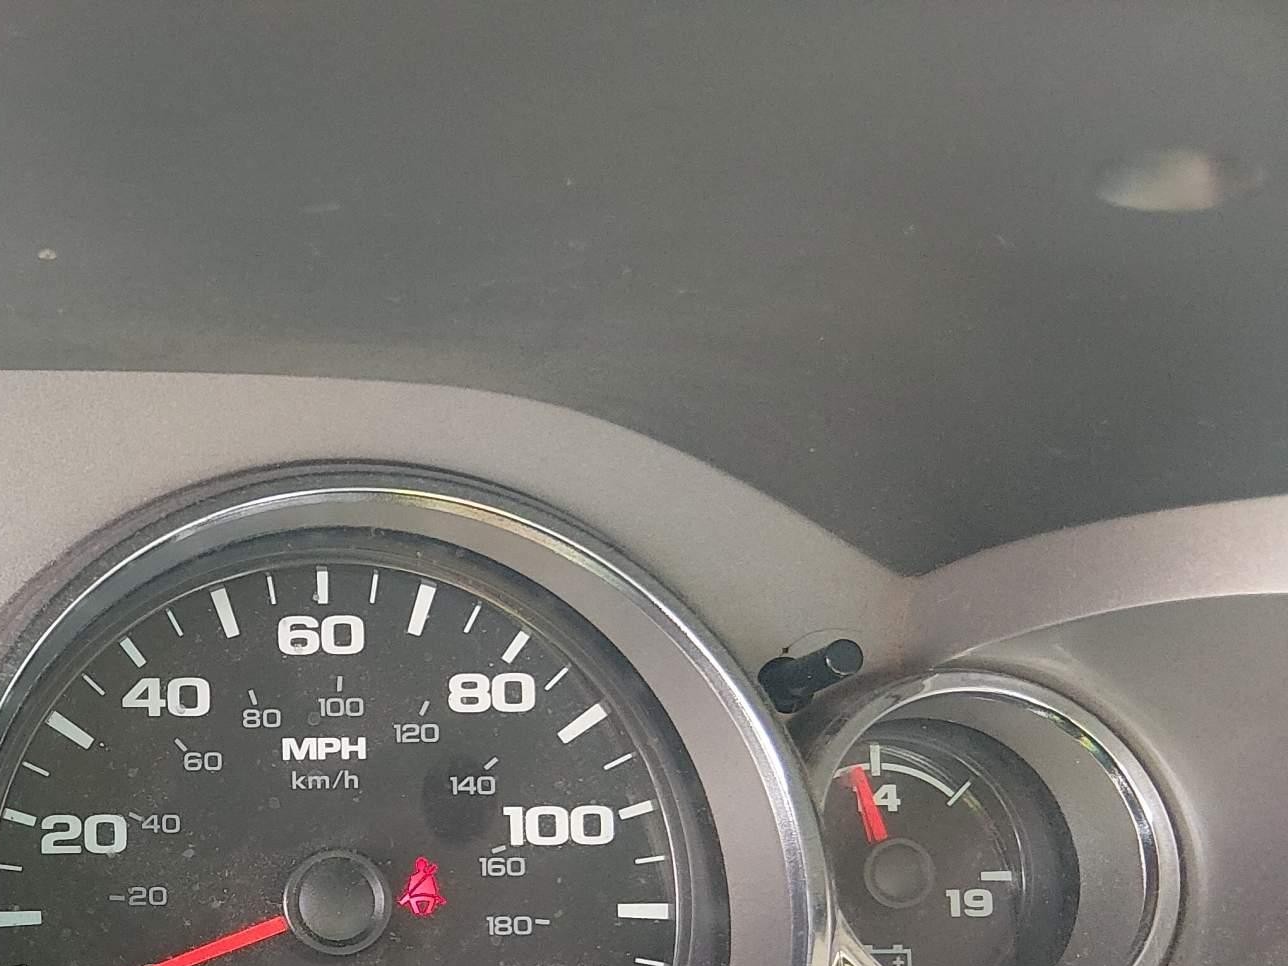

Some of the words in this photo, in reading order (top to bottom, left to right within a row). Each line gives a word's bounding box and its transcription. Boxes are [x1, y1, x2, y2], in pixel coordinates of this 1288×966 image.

[277, 614, 365, 656] 60
[122, 677, 211, 717] 40
[447, 672, 536, 713] 80
[317, 697, 364, 717] 100
[242, 708, 281, 728] 80
[393, 723, 440, 743] 120
[281, 736, 367, 761] MPH
[183, 752, 223, 771] 60
[291, 770, 359, 790] km/h
[449, 776, 496, 795] 140
[141, 814, 181, 833] 40
[503, 806, 615, 845] 100
[41, 814, 128, 854] 20
[479, 857, 526, 877] 160
[128, 886, 167, 906] 20
[945, 888, 994, 918] 19
[486, 916, 533, 936] 180
